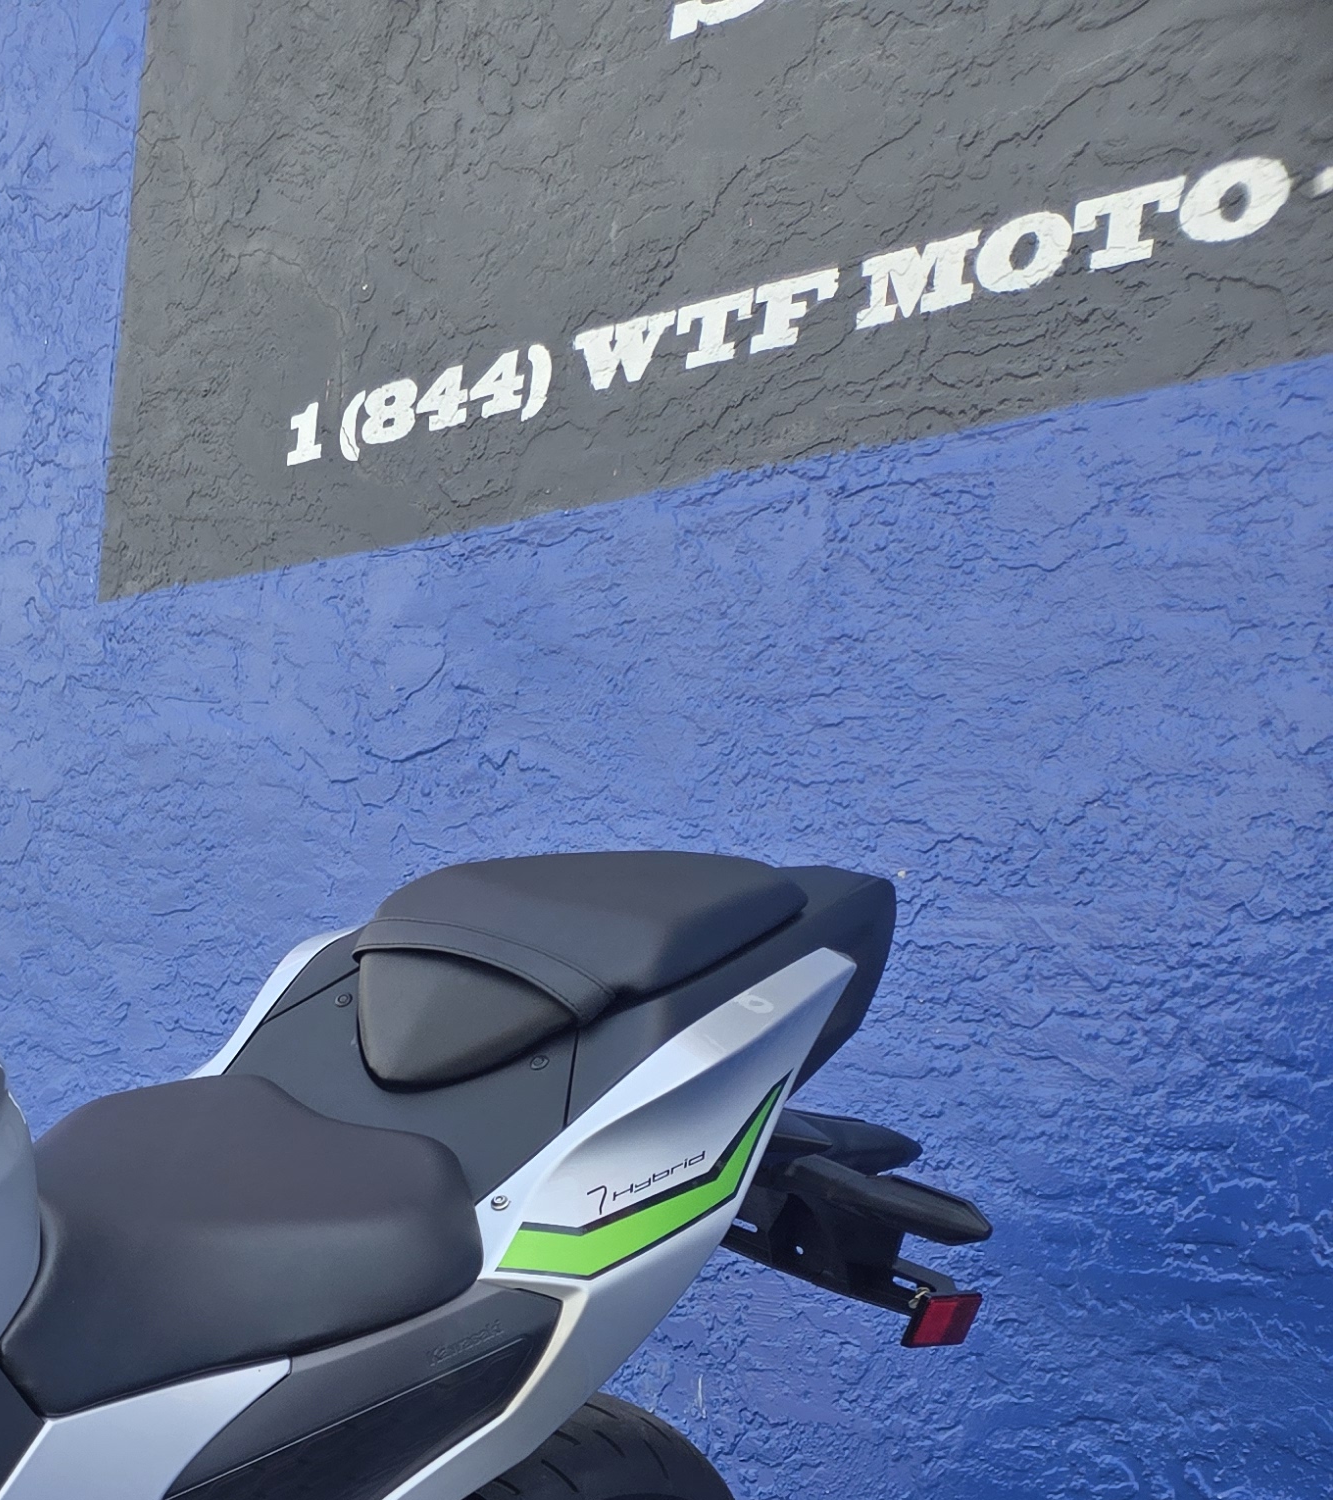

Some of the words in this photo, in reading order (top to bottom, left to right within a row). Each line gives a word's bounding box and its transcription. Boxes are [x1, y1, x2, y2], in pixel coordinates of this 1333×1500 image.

[286, 402, 322, 467] 1
[339, 342, 550, 463] (844)
[572, 266, 840, 391] WTF
[854, 155, 1292, 331] MOTO
[586, 1184, 608, 1216] 7
[612, 1150, 707, 1202] Hybrid
